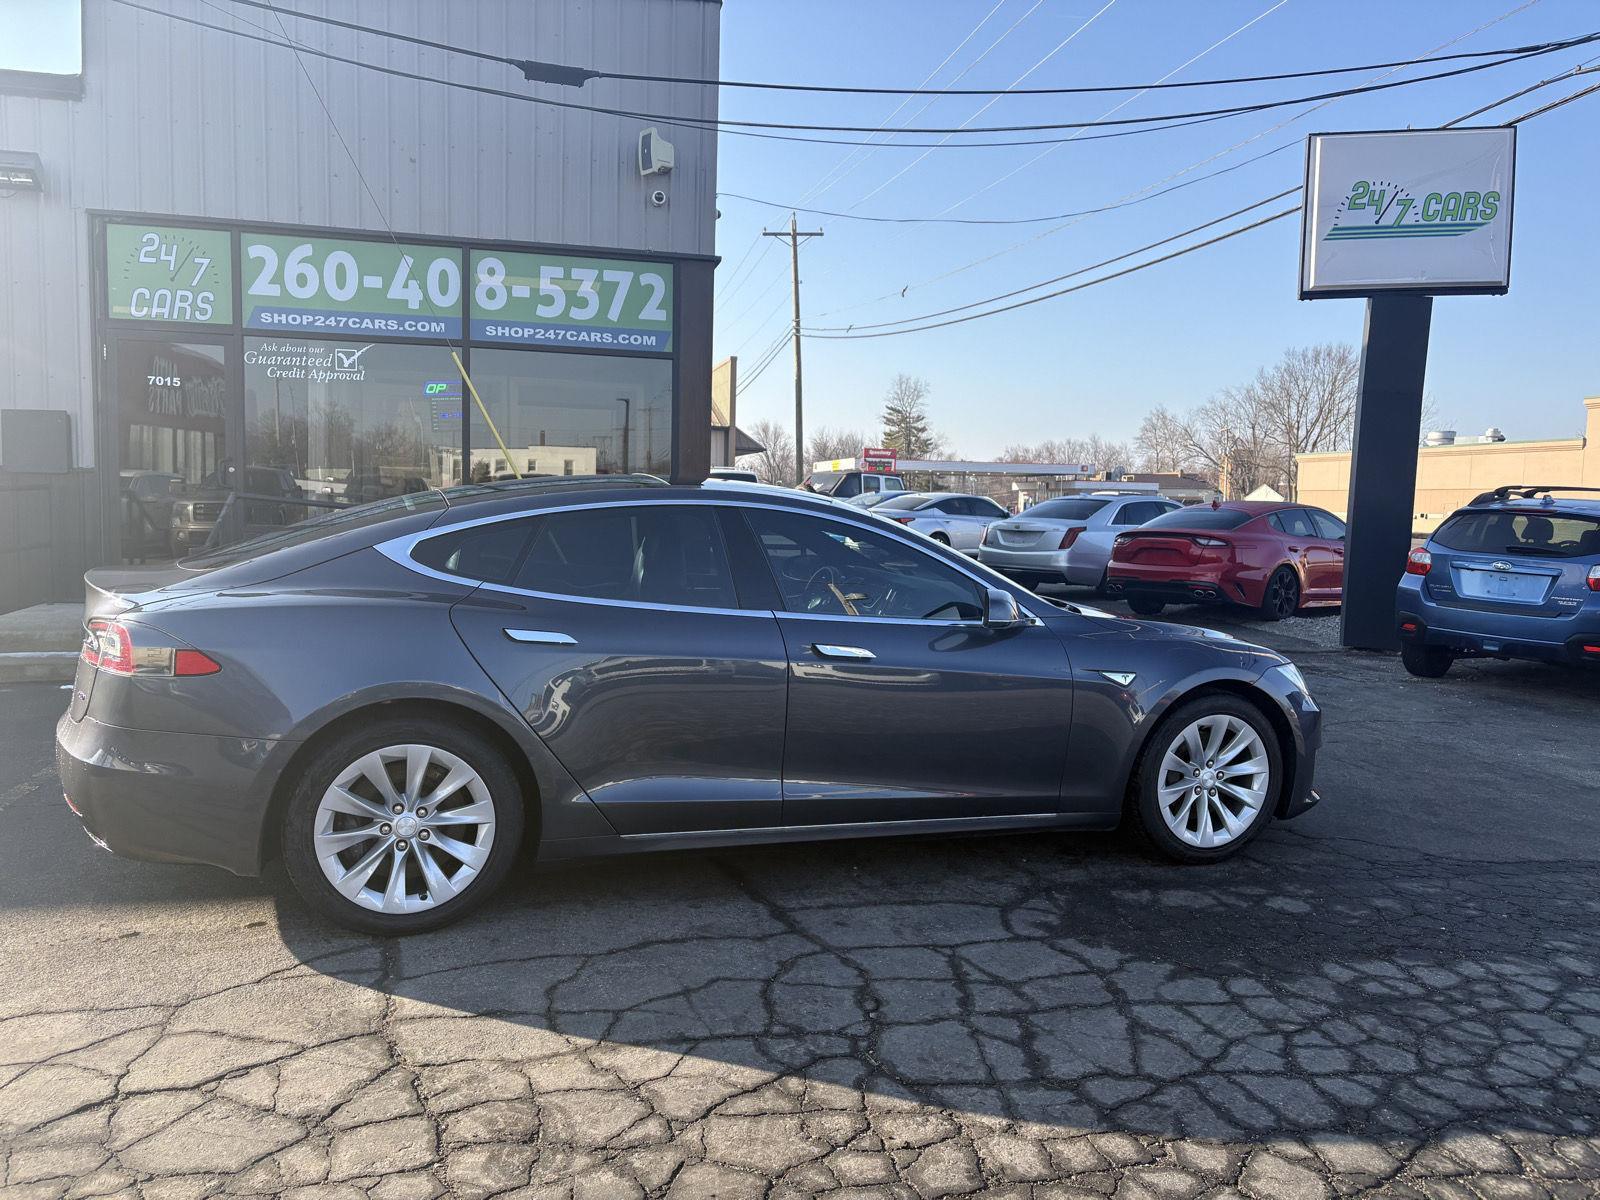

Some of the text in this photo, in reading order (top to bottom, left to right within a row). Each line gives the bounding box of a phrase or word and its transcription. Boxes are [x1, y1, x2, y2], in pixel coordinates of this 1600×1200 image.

[1422, 191, 1500, 222] CARS
[130, 287, 215, 321] CARS
[260, 312, 445, 333] SHOP247CARS.COM
[485, 325, 656, 346] SHOP247CARS.COM
[260, 343, 325, 354] Ask about our
[243, 350, 333, 367] Guaranteed
[147, 376, 181, 387] 7015
[266, 366, 366, 383] Credit Approval
